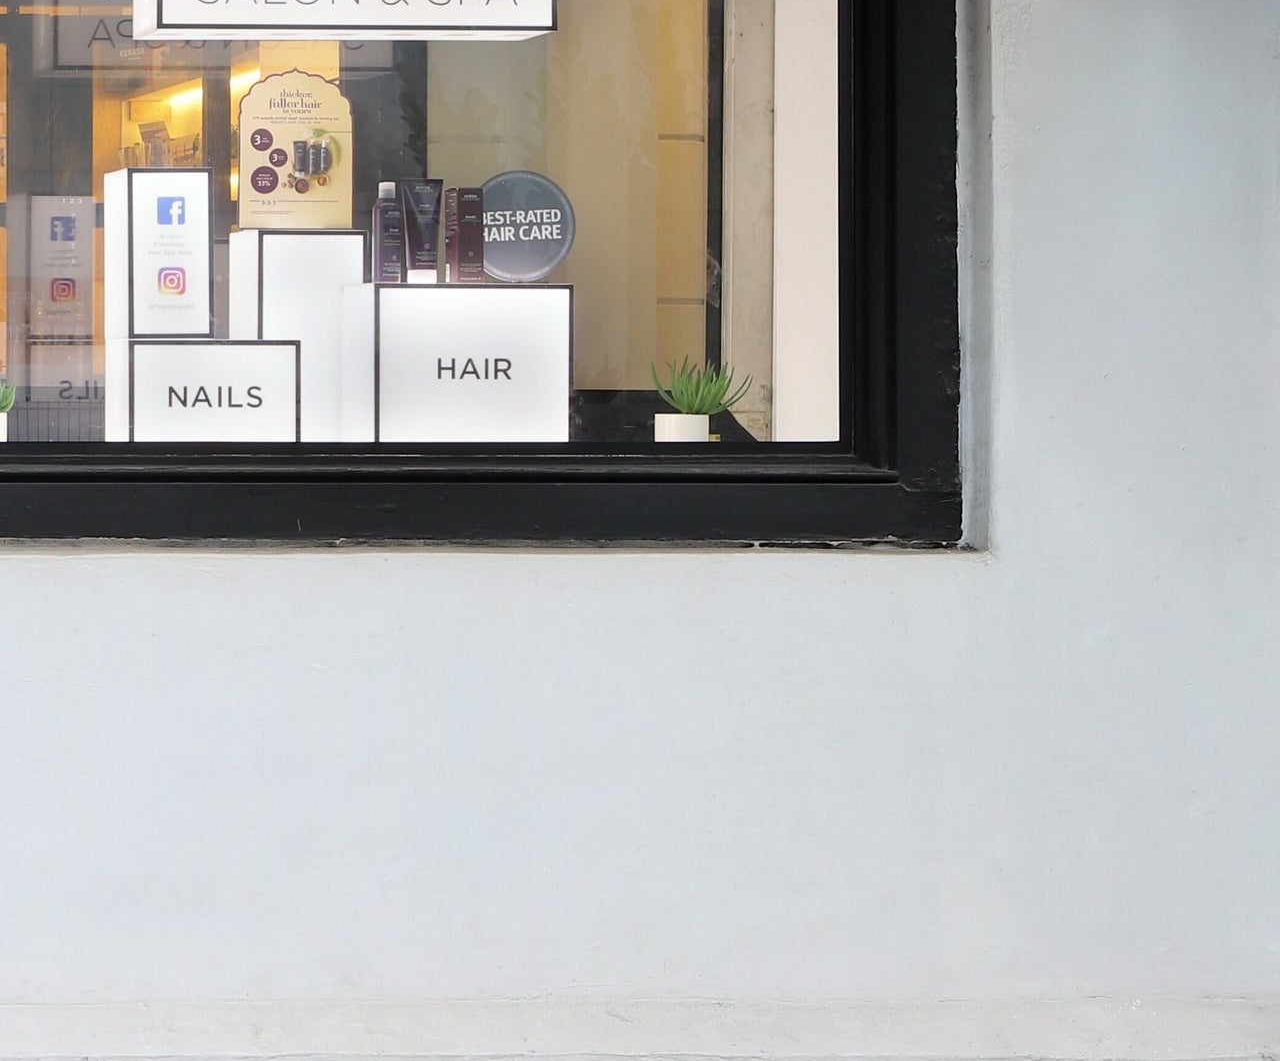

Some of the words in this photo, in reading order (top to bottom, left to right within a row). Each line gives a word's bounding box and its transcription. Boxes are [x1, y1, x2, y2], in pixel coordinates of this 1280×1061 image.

[300, 98, 323, 109] hair
[253, 134, 261, 145] 3
[271, 153, 278, 162] 3
[519, 224, 562, 241] CARE
[437, 358, 513, 380] HAIR
[167, 386, 263, 408] NAILS
